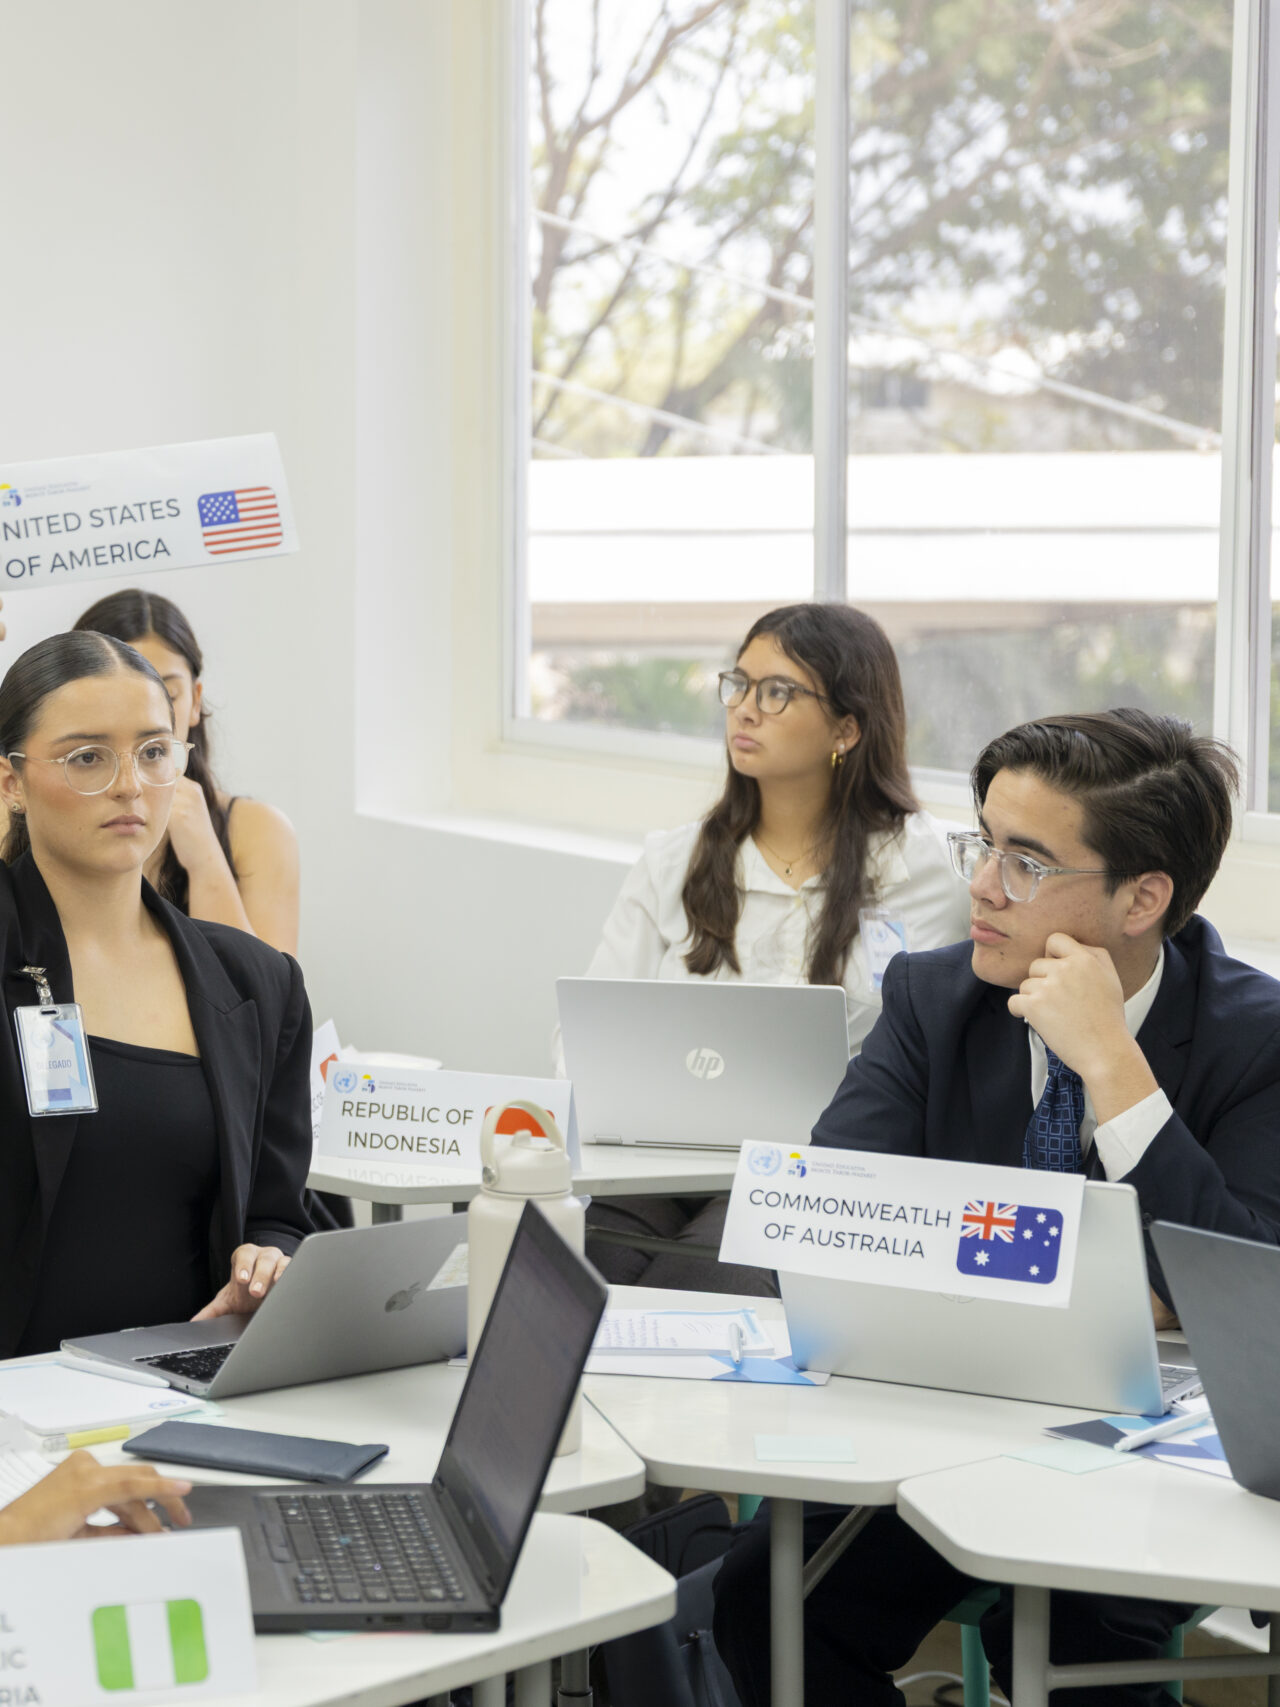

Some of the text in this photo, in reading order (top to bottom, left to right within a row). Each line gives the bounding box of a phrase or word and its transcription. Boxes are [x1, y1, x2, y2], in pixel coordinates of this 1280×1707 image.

[89, 499, 181, 529] STATES
[5, 538, 171, 579] OF AMERICA
[689, 1048, 722, 1080] hp
[341, 1100, 441, 1124] REPUBLIC
[445, 1108, 474, 1126] OF
[347, 1130, 461, 1156] INDONESIA
[749, 1189, 951, 1229] COMMONWEATLH
[763, 1223, 925, 1259] OF AUSTRALIA
